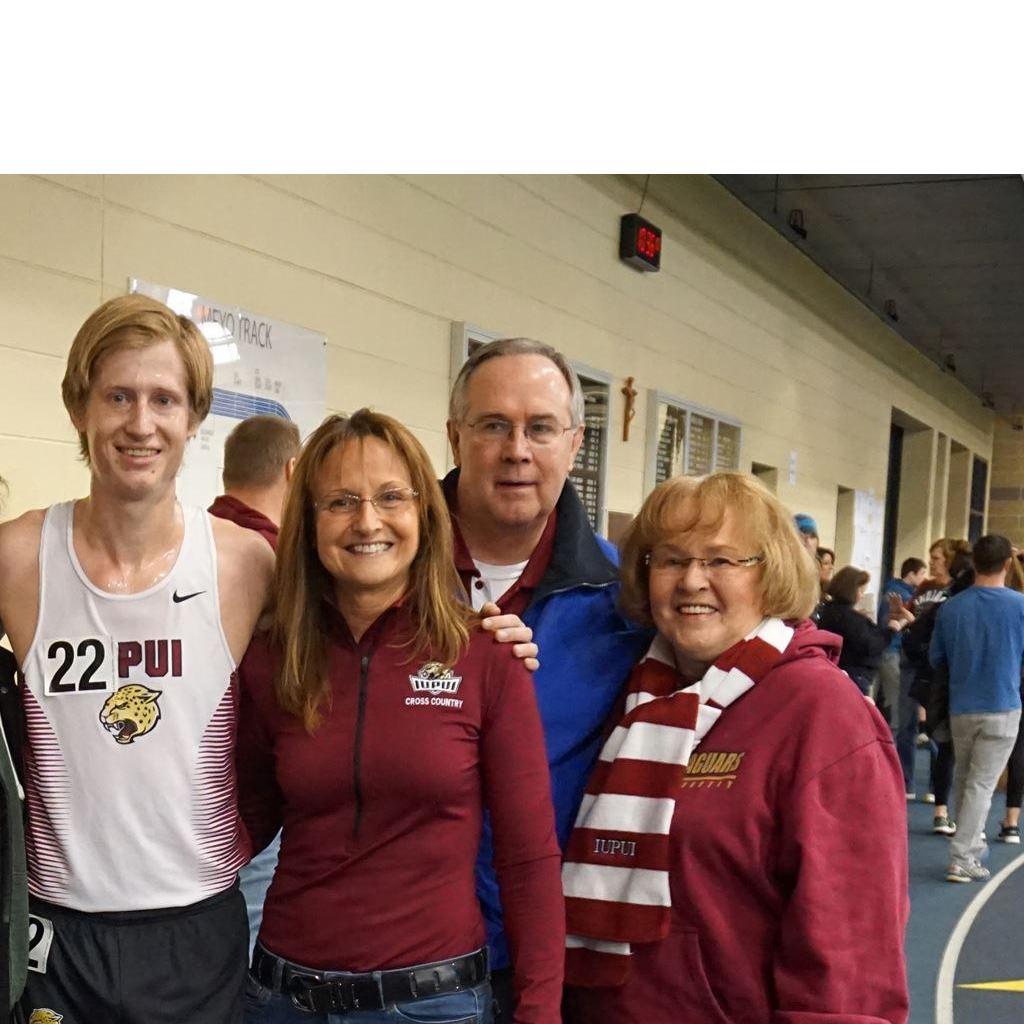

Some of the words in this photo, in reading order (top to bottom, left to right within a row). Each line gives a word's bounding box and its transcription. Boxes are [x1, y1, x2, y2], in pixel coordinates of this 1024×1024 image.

[239, 316, 273, 350] TRACK
[48, 638, 107, 693] 22
[117, 639, 182, 678] PUI
[405, 697, 430, 706] CROSS
[431, 697, 463, 708] COUNTRY
[593, 838, 637, 857] IUPUI
